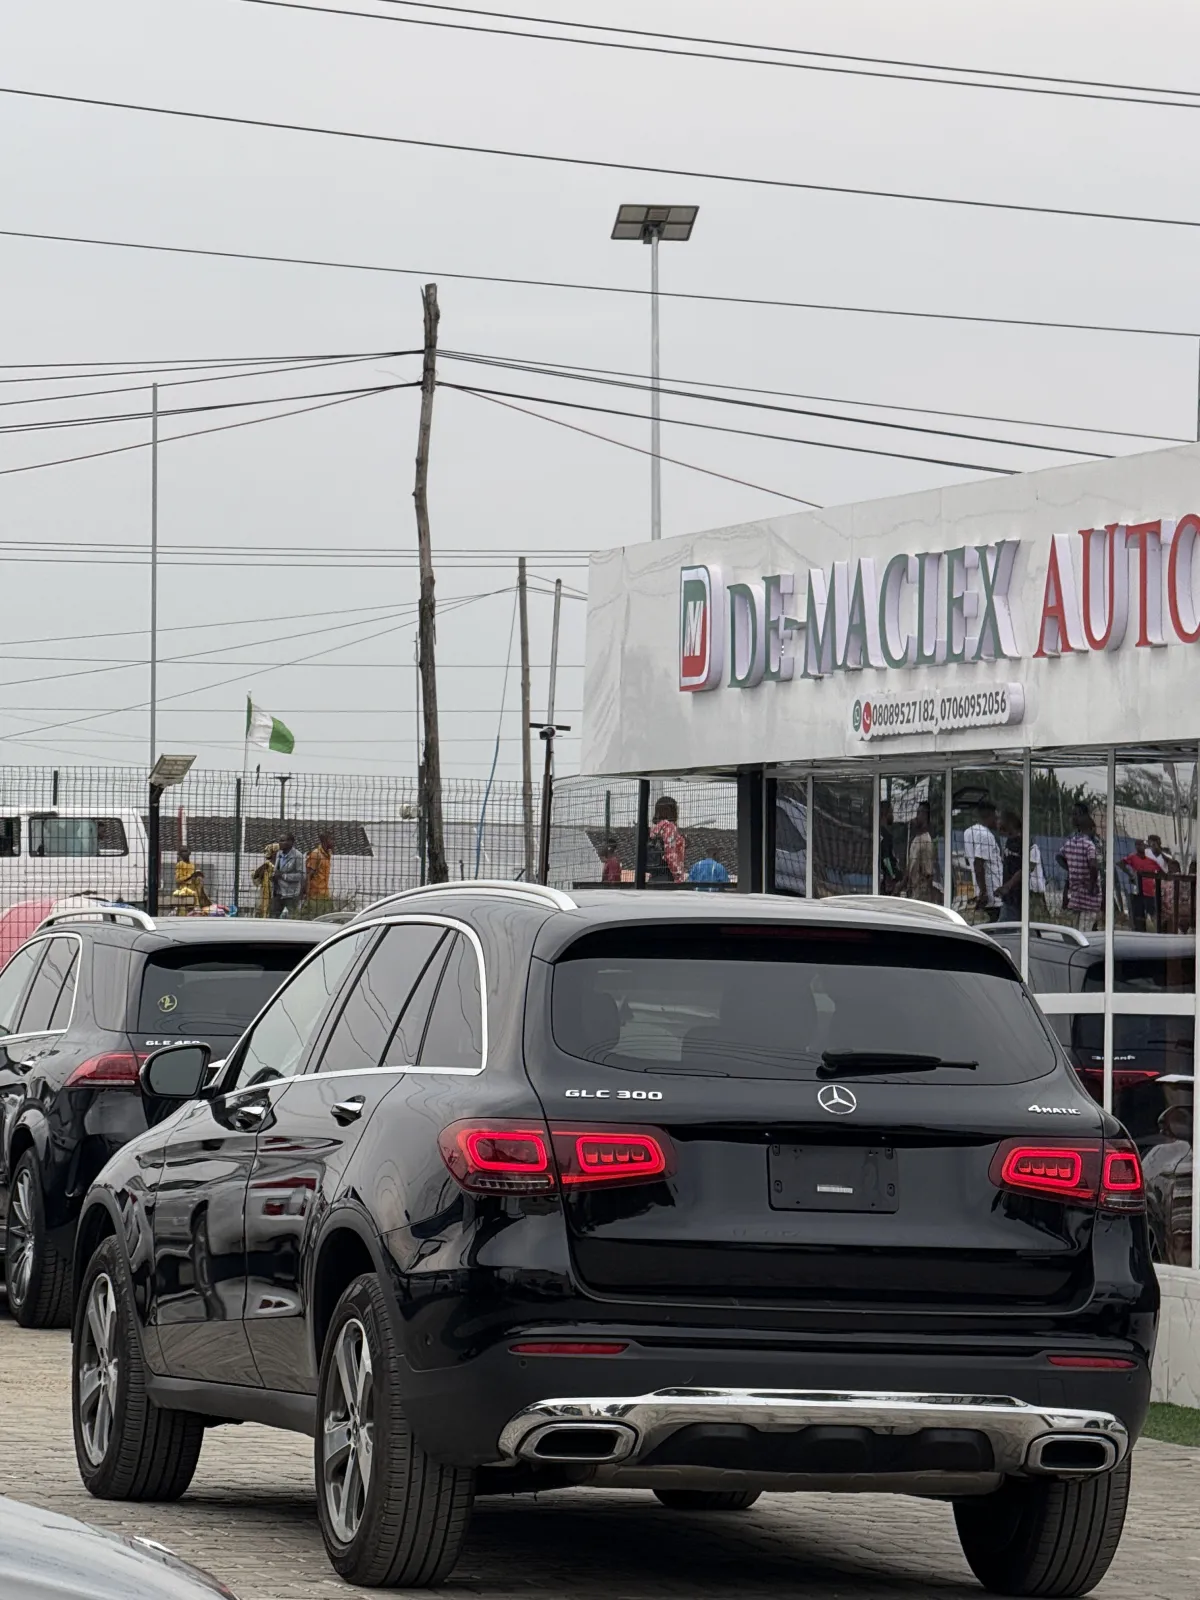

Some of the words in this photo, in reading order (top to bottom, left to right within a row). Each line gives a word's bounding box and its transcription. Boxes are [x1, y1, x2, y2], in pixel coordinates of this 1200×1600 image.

[727, 539, 1020, 688] DE-MACLEX
[872, 699, 939, 726] 08089527182,
[940, 691, 1007, 719] 07060952056
[565, 1089, 610, 1099] GLC
[616, 1090, 663, 1101] 300
[1028, 1104, 1081, 1115] 4MATIC
